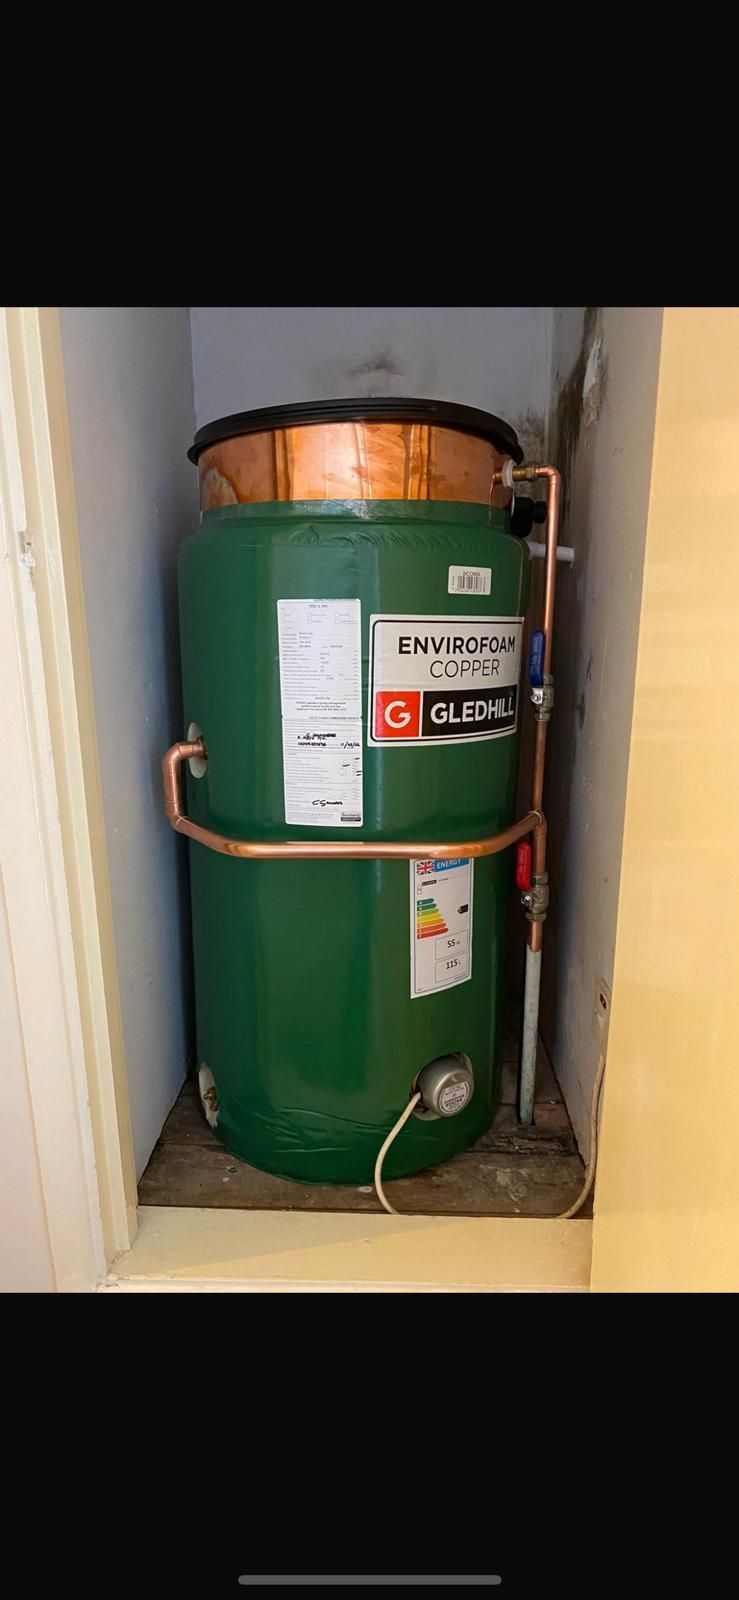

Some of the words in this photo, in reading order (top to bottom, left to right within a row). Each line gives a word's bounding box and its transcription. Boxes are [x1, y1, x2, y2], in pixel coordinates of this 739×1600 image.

[398, 636, 515, 655] ENVIROFOAM
[429, 659, 500, 679] COPPER
[384, 700, 412, 729] G
[430, 696, 514, 725] GLEDHILL
[447, 939, 456, 949] 55
[446, 959, 458, 970] 115
